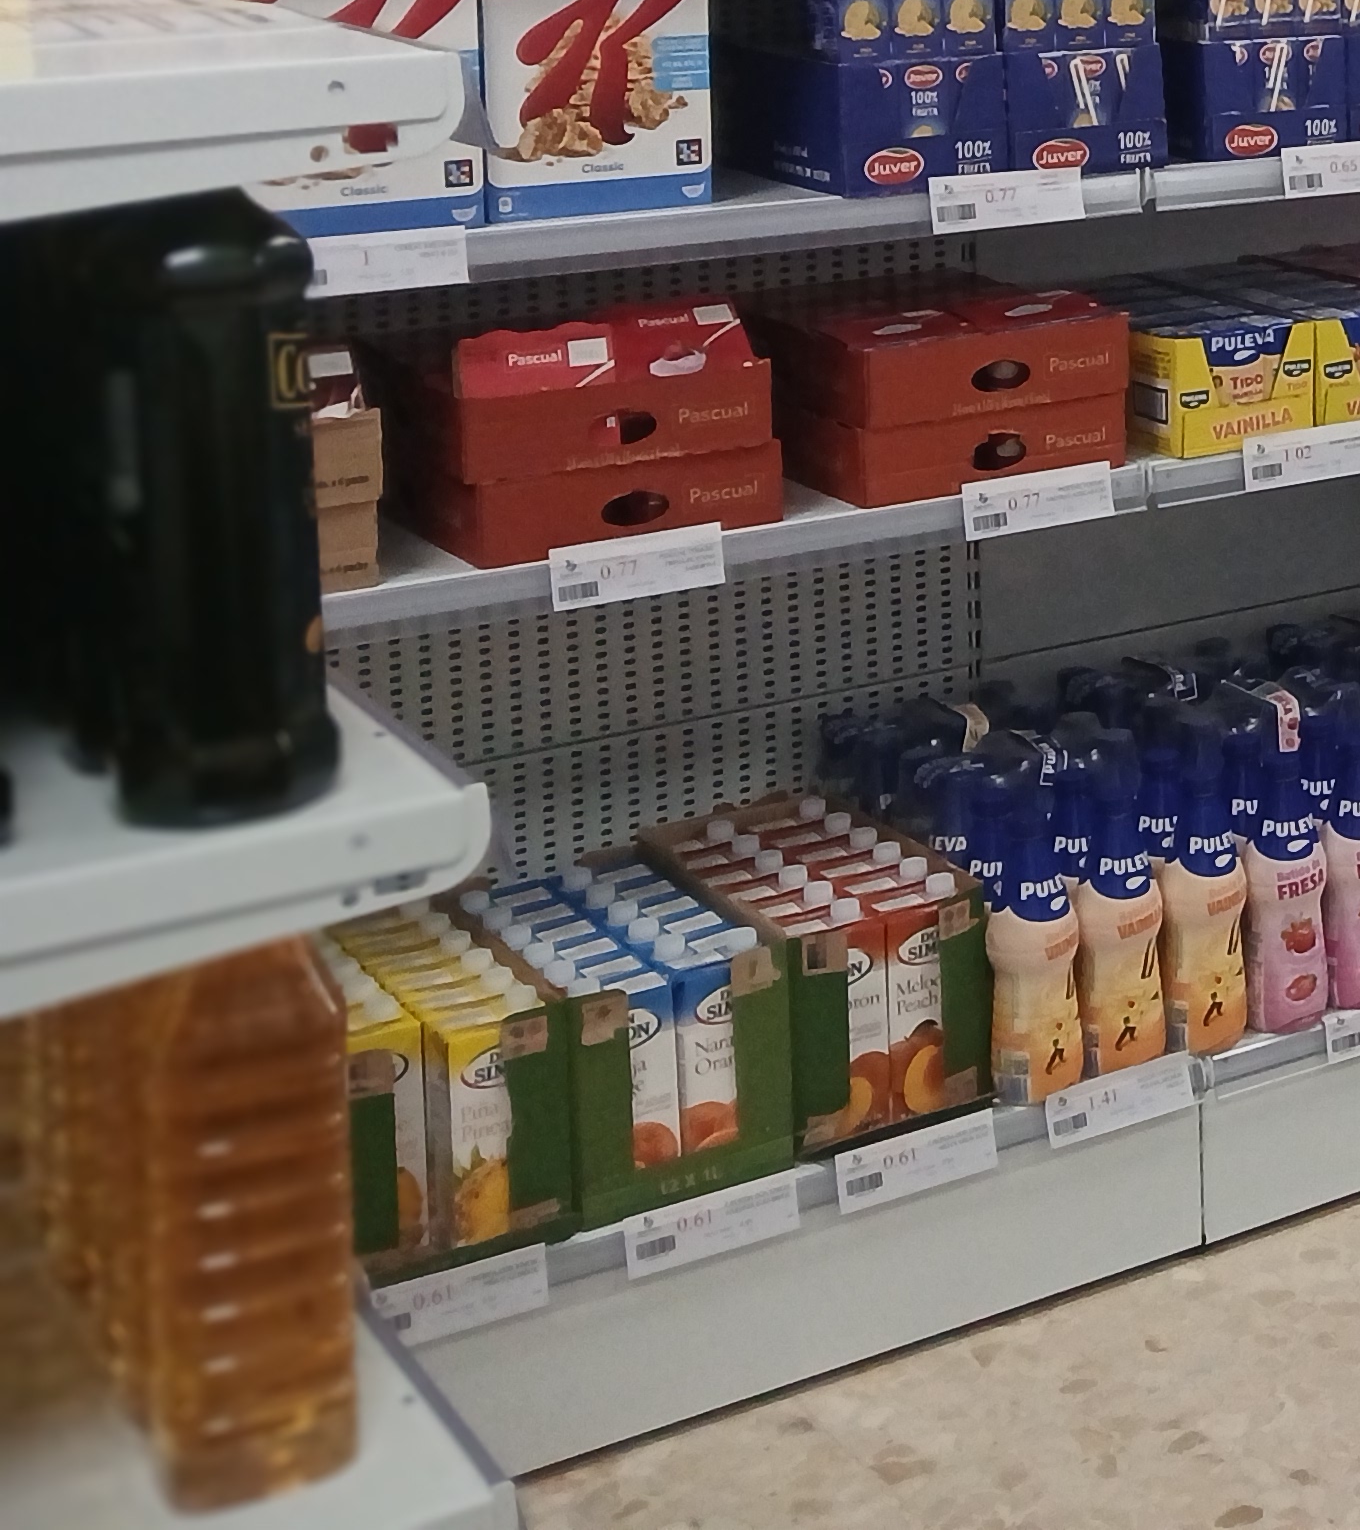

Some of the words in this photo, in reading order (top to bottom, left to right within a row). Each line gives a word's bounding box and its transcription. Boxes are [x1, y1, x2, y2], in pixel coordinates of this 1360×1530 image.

[910, 91, 939, 105] 100%
[1305, 119, 1337, 136] 100%
[954, 140, 992, 159] 100%
[1117, 130, 1151, 150] 100%
[1230, 133, 1271, 148] Juver
[581, 161, 624, 174] Classic
[870, 158, 919, 176] Juver
[1037, 149, 1084, 167] Juver
[1330, 158, 1358, 174] 0.65
[340, 184, 387, 197] Classic
[985, 188, 1017, 204] 0.77
[638, 313, 689, 328] Pascual
[1211, 329, 1275, 353] PULEVA
[508, 350, 563, 367] Pascual
[1050, 352, 1110, 372] Pascual
[678, 402, 749, 424] Pascual
[1212, 408, 1293, 440] VAINILLA
[1045, 426, 1106, 450] Pascual
[689, 480, 758, 504] Pascual
[1008, 493, 1040, 511] 0.77
[600, 560, 638, 580] 0.77
[1277, 868, 1324, 900] FRESA
[897, 990, 938, 1015] Peach
[883, 1147, 919, 1169] 0.61
[676, 1209, 714, 1233] 0.61
[412, 1284, 454, 1309] 0.61
